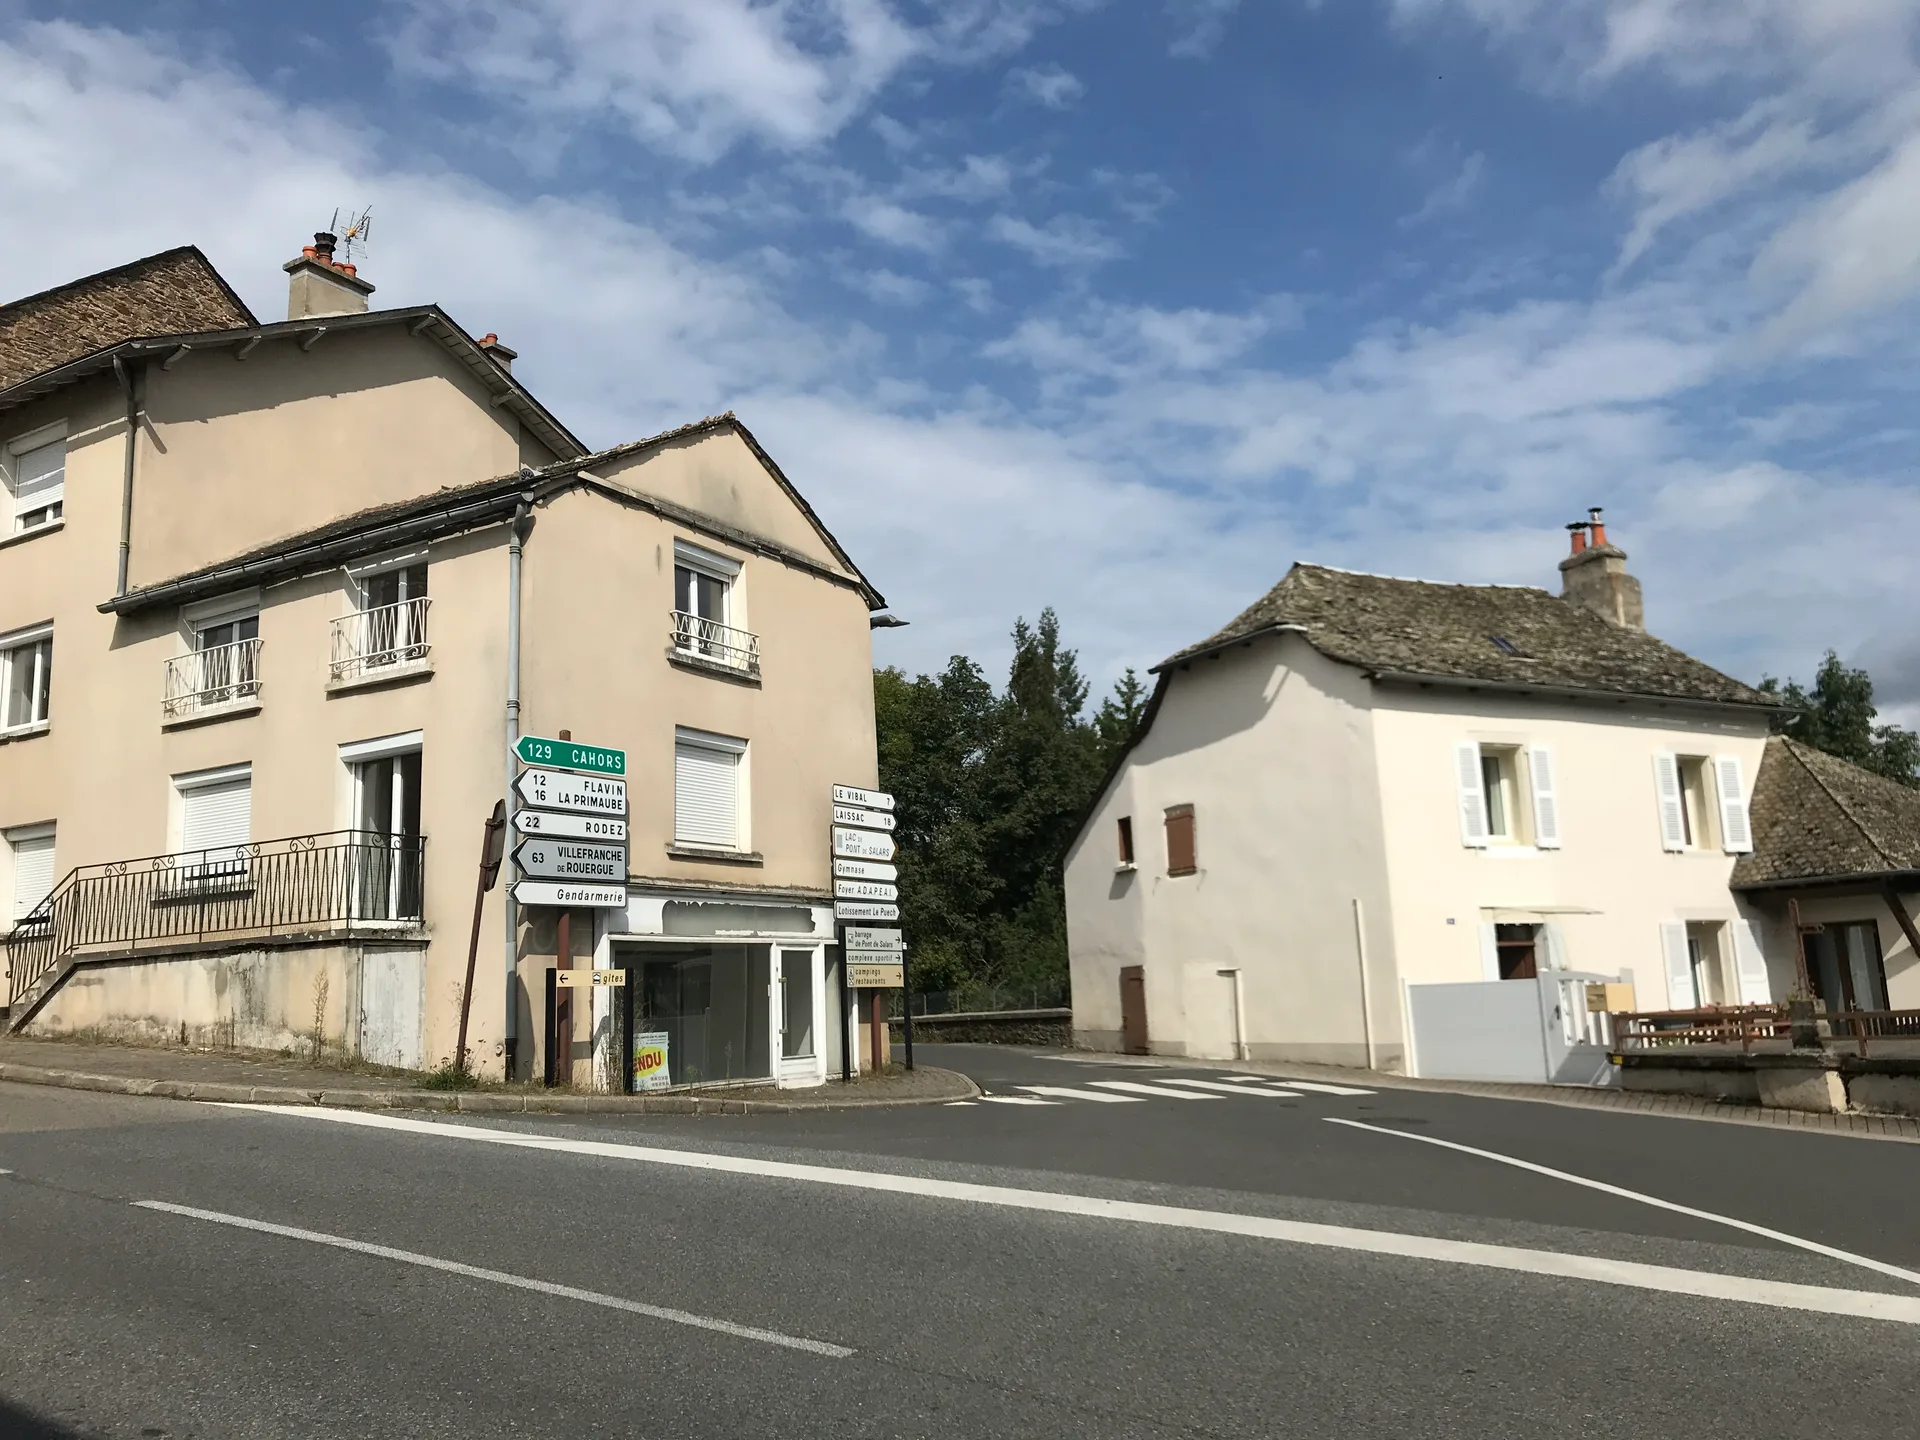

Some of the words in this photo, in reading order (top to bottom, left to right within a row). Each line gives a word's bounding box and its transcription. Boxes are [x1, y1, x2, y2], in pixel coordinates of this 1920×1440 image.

[528, 743, 552, 759] 129
[572, 750, 621, 769] CAHORS
[533, 774, 546, 786] 12
[584, 781, 623, 796] FLAVIN
[535, 789, 546, 801] 16
[558, 792, 570, 804] LA
[574, 795, 623, 810] PRIMAUBE
[835, 789, 843, 798] LE
[847, 790, 867, 802] VIBAL
[886, 797, 890, 806] 7
[836, 810, 864, 822] LAISSAC
[884, 817, 891, 826] 18
[525, 816, 540, 828] 22
[585, 822, 623, 836] RODEZ
[845, 832, 857, 842] LAC
[557, 846, 623, 862] VILLEFRANCHE
[845, 843, 861, 854] PONT
[869, 846, 890, 857] SALARS
[532, 852, 545, 864] 63
[557, 865, 565, 873] DE
[566, 862, 614, 876] ROUERGUE
[838, 864, 865, 874] Gymnase
[557, 888, 623, 903] Gendarmerie
[838, 884, 854, 894] Foyer
[838, 906, 872, 916] Lotissement
[872, 907, 879, 916] Le
[880, 907, 896, 917] Puech
[855, 940, 861, 948] de
[861, 940, 873, 948] Pont
[879, 940, 894, 949] Salars
[847, 953, 873, 963] complexe
[875, 953, 893, 963] sportif
[855, 968, 881, 977] campings
[633, 1051, 661, 1072] ENDU
